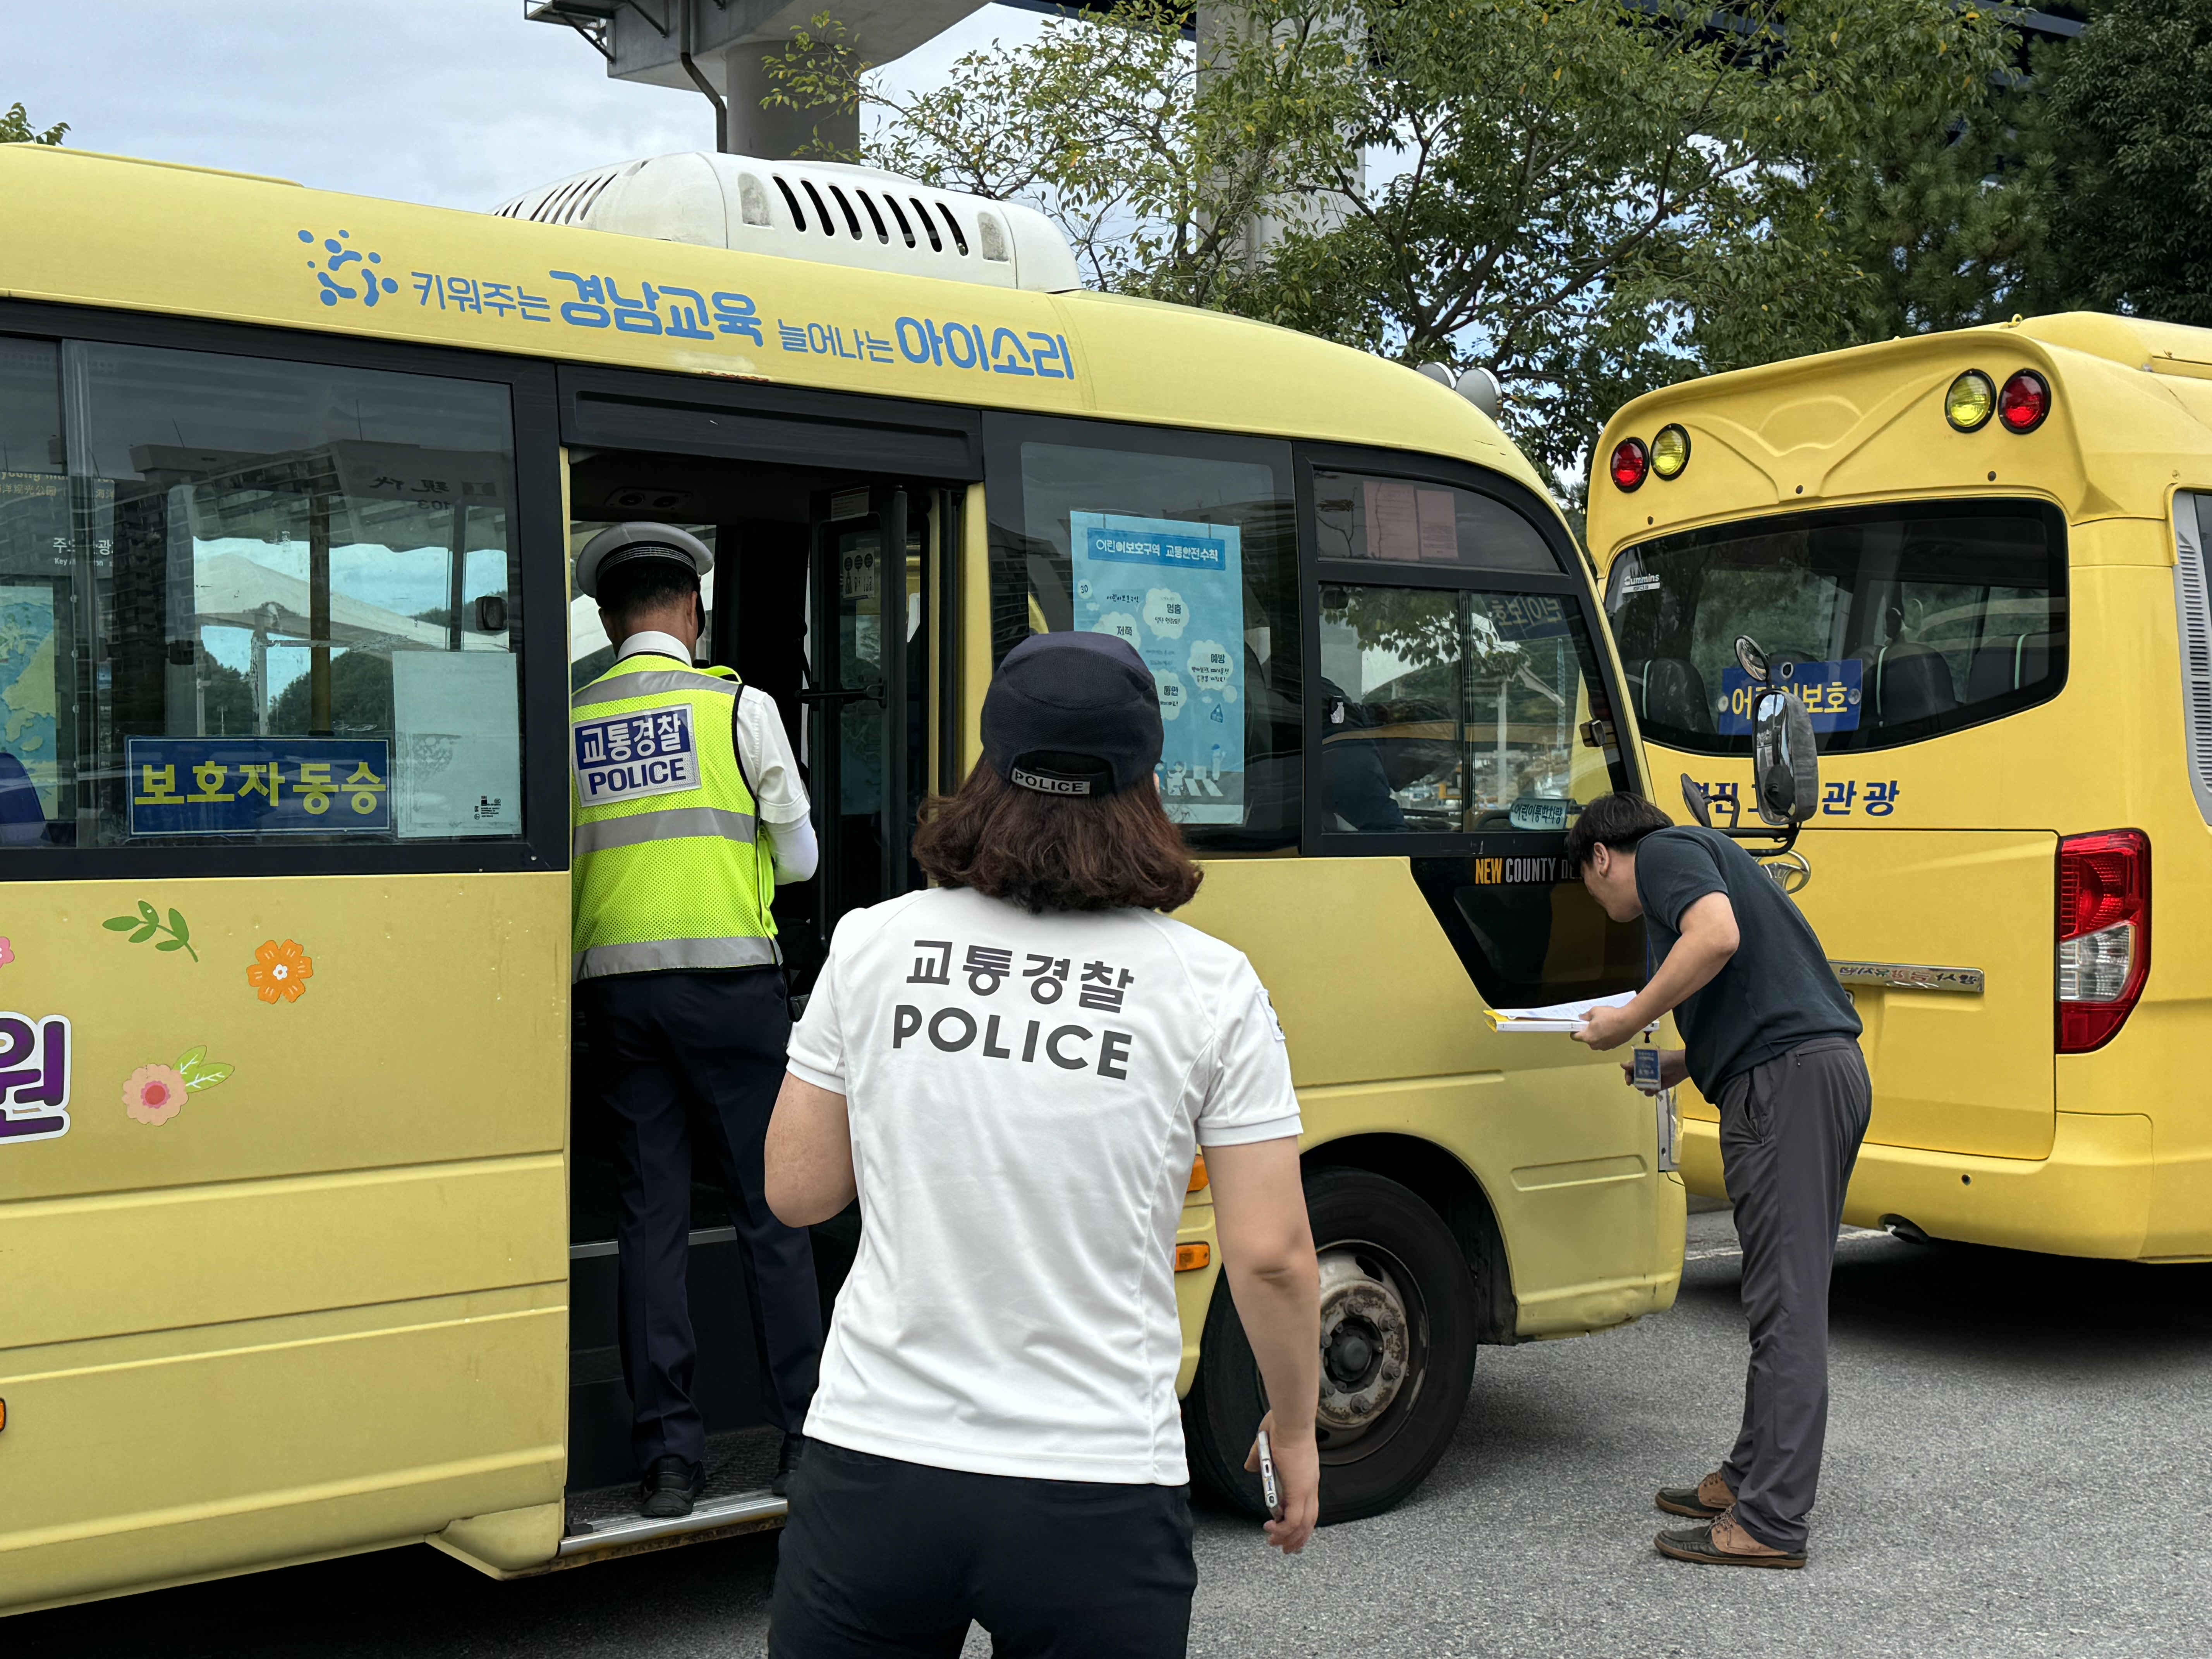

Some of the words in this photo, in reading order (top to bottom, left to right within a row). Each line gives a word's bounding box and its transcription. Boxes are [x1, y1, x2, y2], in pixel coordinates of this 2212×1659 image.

[411, 271, 551, 323] 키워주는
[549, 270, 763, 347] 경남교육
[777, 318, 895, 364] 늘어나는
[895, 316, 1075, 380] 아이소리
[1096, 539, 1161, 556] 어린이보호구역
[1165, 544, 1218, 562] 교통안전수칙
[1080, 584, 1089, 594] 30
[1732, 682, 1848, 720] 어보호
[582, 714, 681, 764] 교통경찰
[588, 758, 687, 795] POLICE
[1015, 770, 1084, 792] POLICE
[1475, 858, 1503, 884] NEW
[1505, 857, 1556, 883] COUNTY
[906, 940, 1134, 1013] 교통경찰
[893, 1005, 1133, 1080] POLICE
